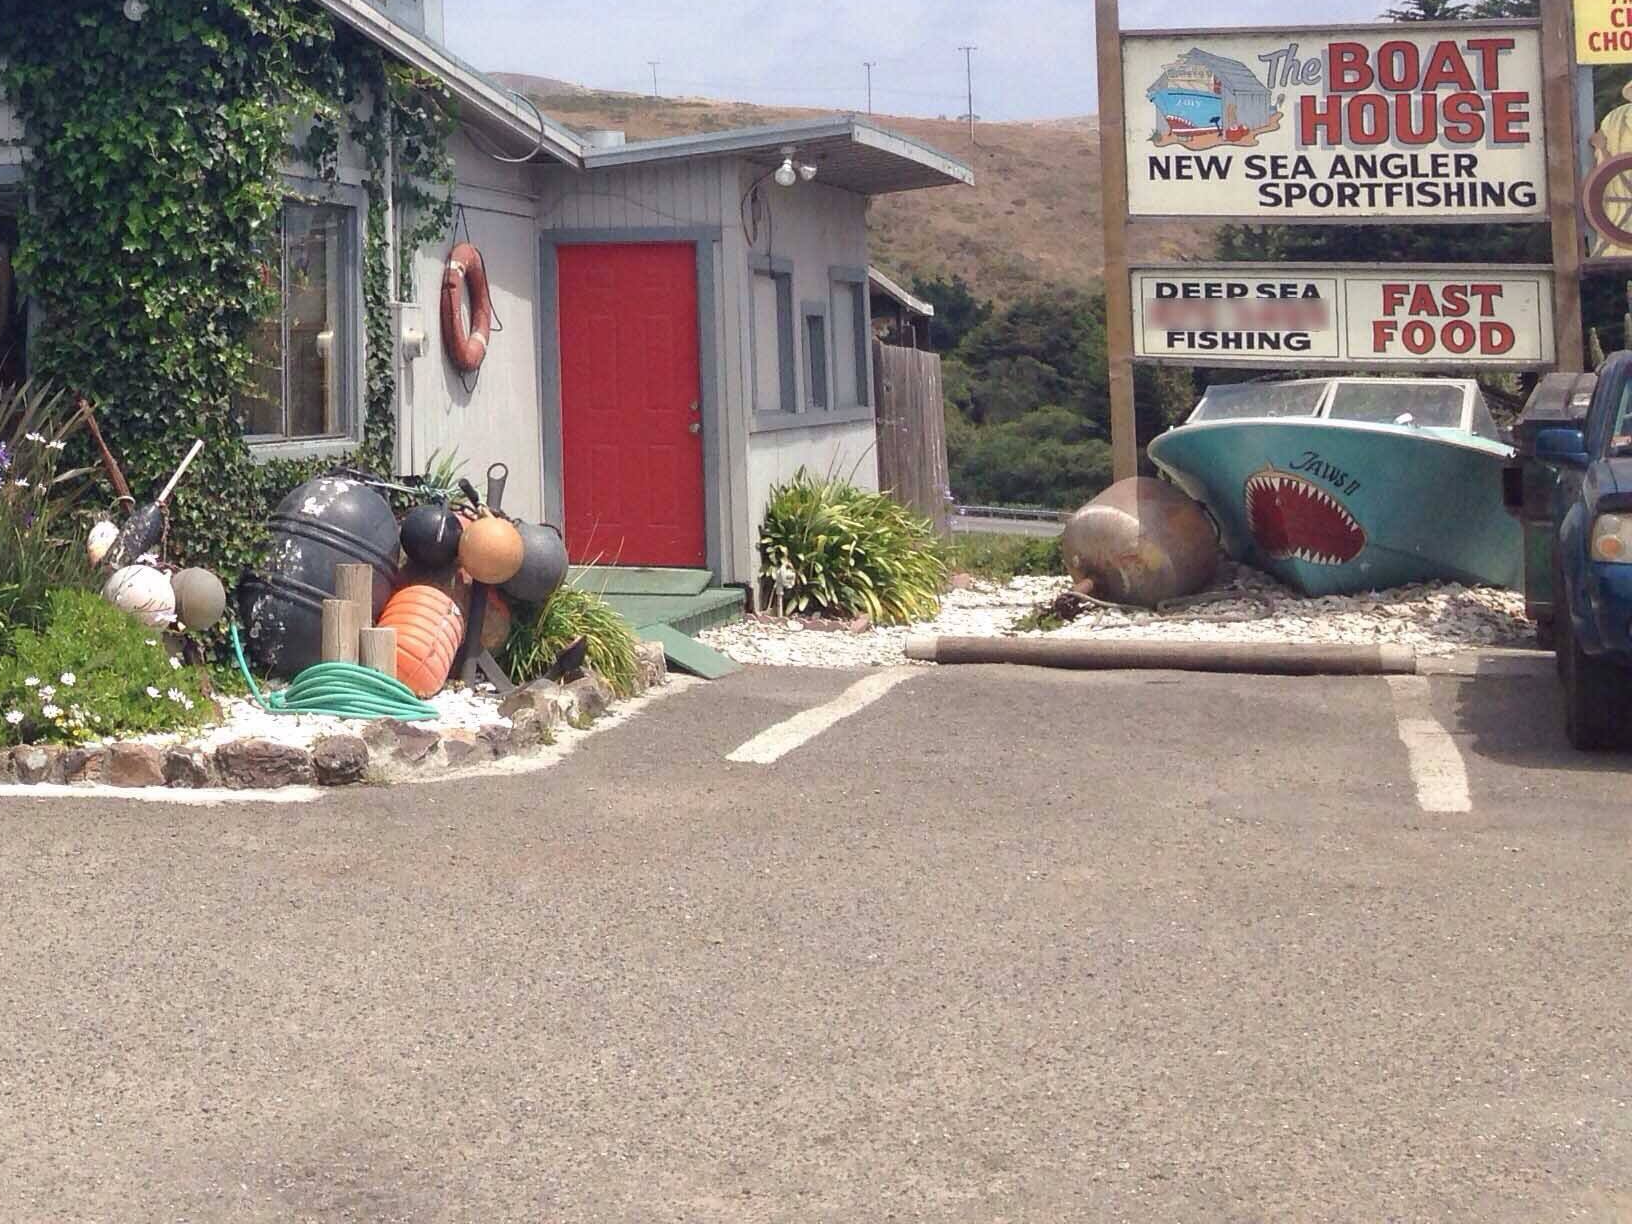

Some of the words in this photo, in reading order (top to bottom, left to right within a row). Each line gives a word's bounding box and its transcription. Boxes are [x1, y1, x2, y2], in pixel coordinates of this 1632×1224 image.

[1257, 43, 1322, 89] The
[1327, 39, 1515, 93] BOAT
[1300, 91, 1530, 146] HOUSE
[1148, 155, 1233, 181] NEW
[1244, 154, 1317, 180] SEA
[1328, 153, 1479, 180] ANGLER
[1258, 181, 1537, 208] SPORTFISHING
[1156, 283, 1249, 299] DEEP
[1256, 283, 1321, 299] SEA
[1382, 284, 1503, 317] FAST
[1167, 331, 1312, 351] FISHING
[1372, 320, 1515, 355] FOOD
